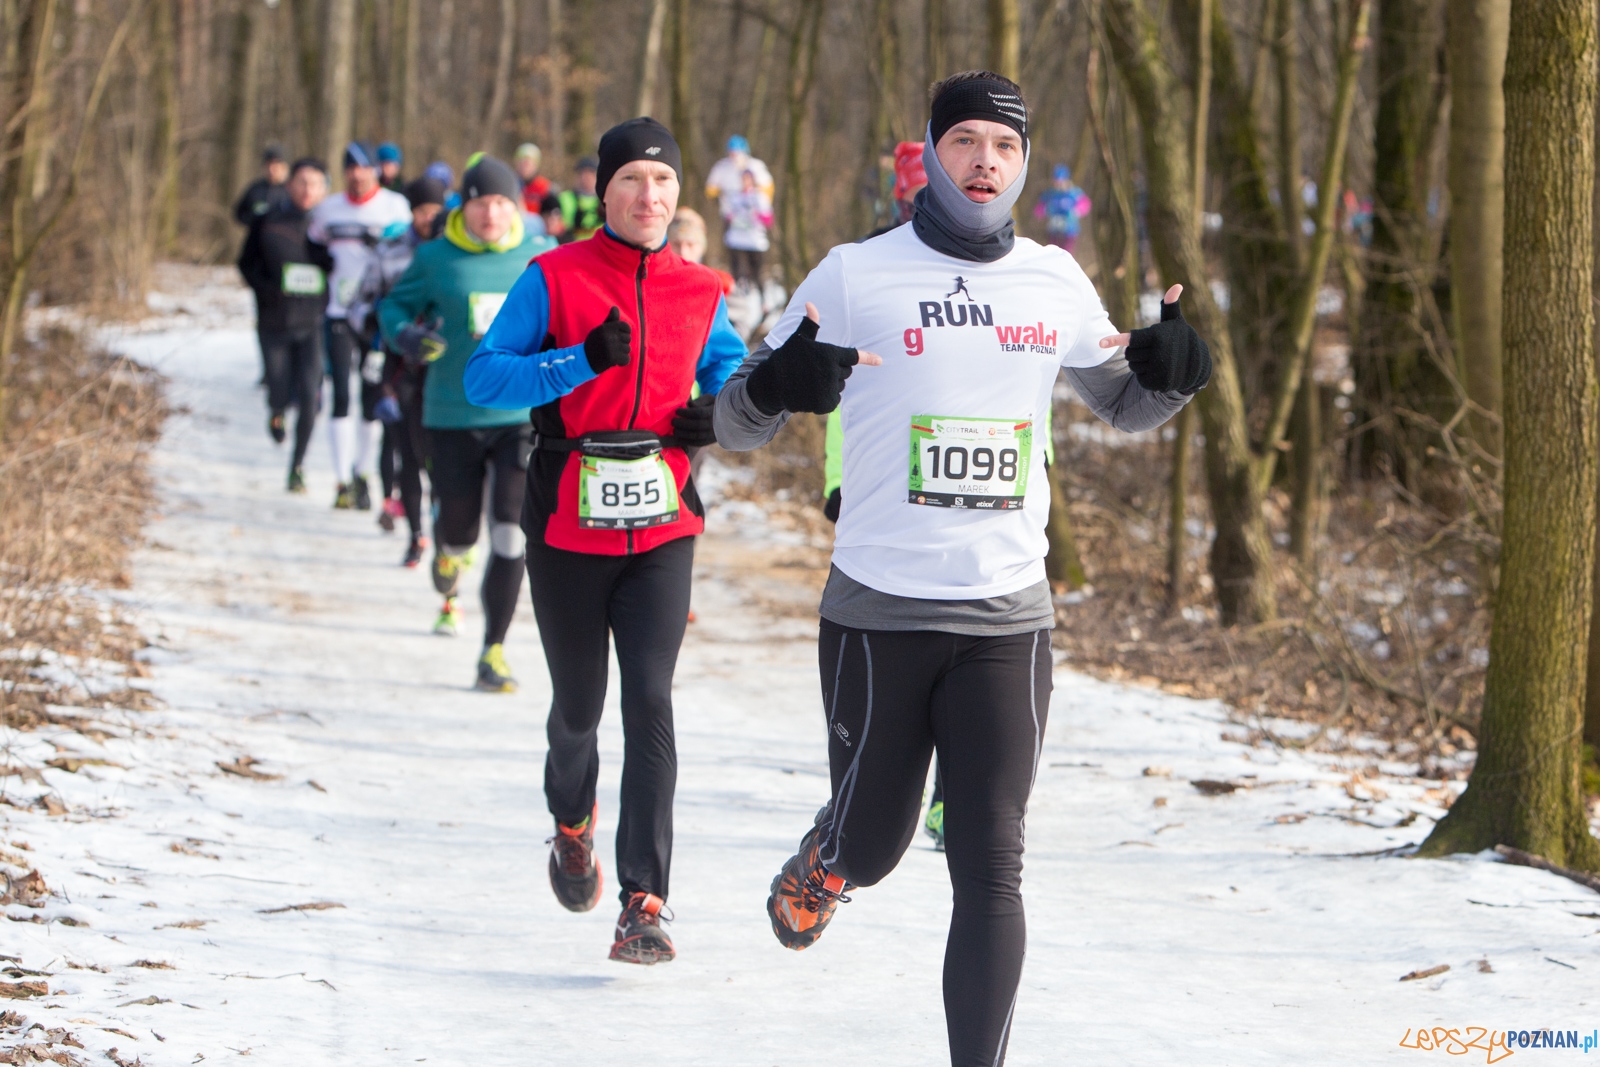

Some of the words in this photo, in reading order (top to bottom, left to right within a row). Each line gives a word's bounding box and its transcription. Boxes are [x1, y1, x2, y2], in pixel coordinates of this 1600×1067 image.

[919, 300, 994, 328] RUN
[1000, 343, 1025, 352] TEAM
[927, 445, 1018, 482] 1098
[601, 478, 660, 507] 855
[958, 484, 990, 494] MAREK
